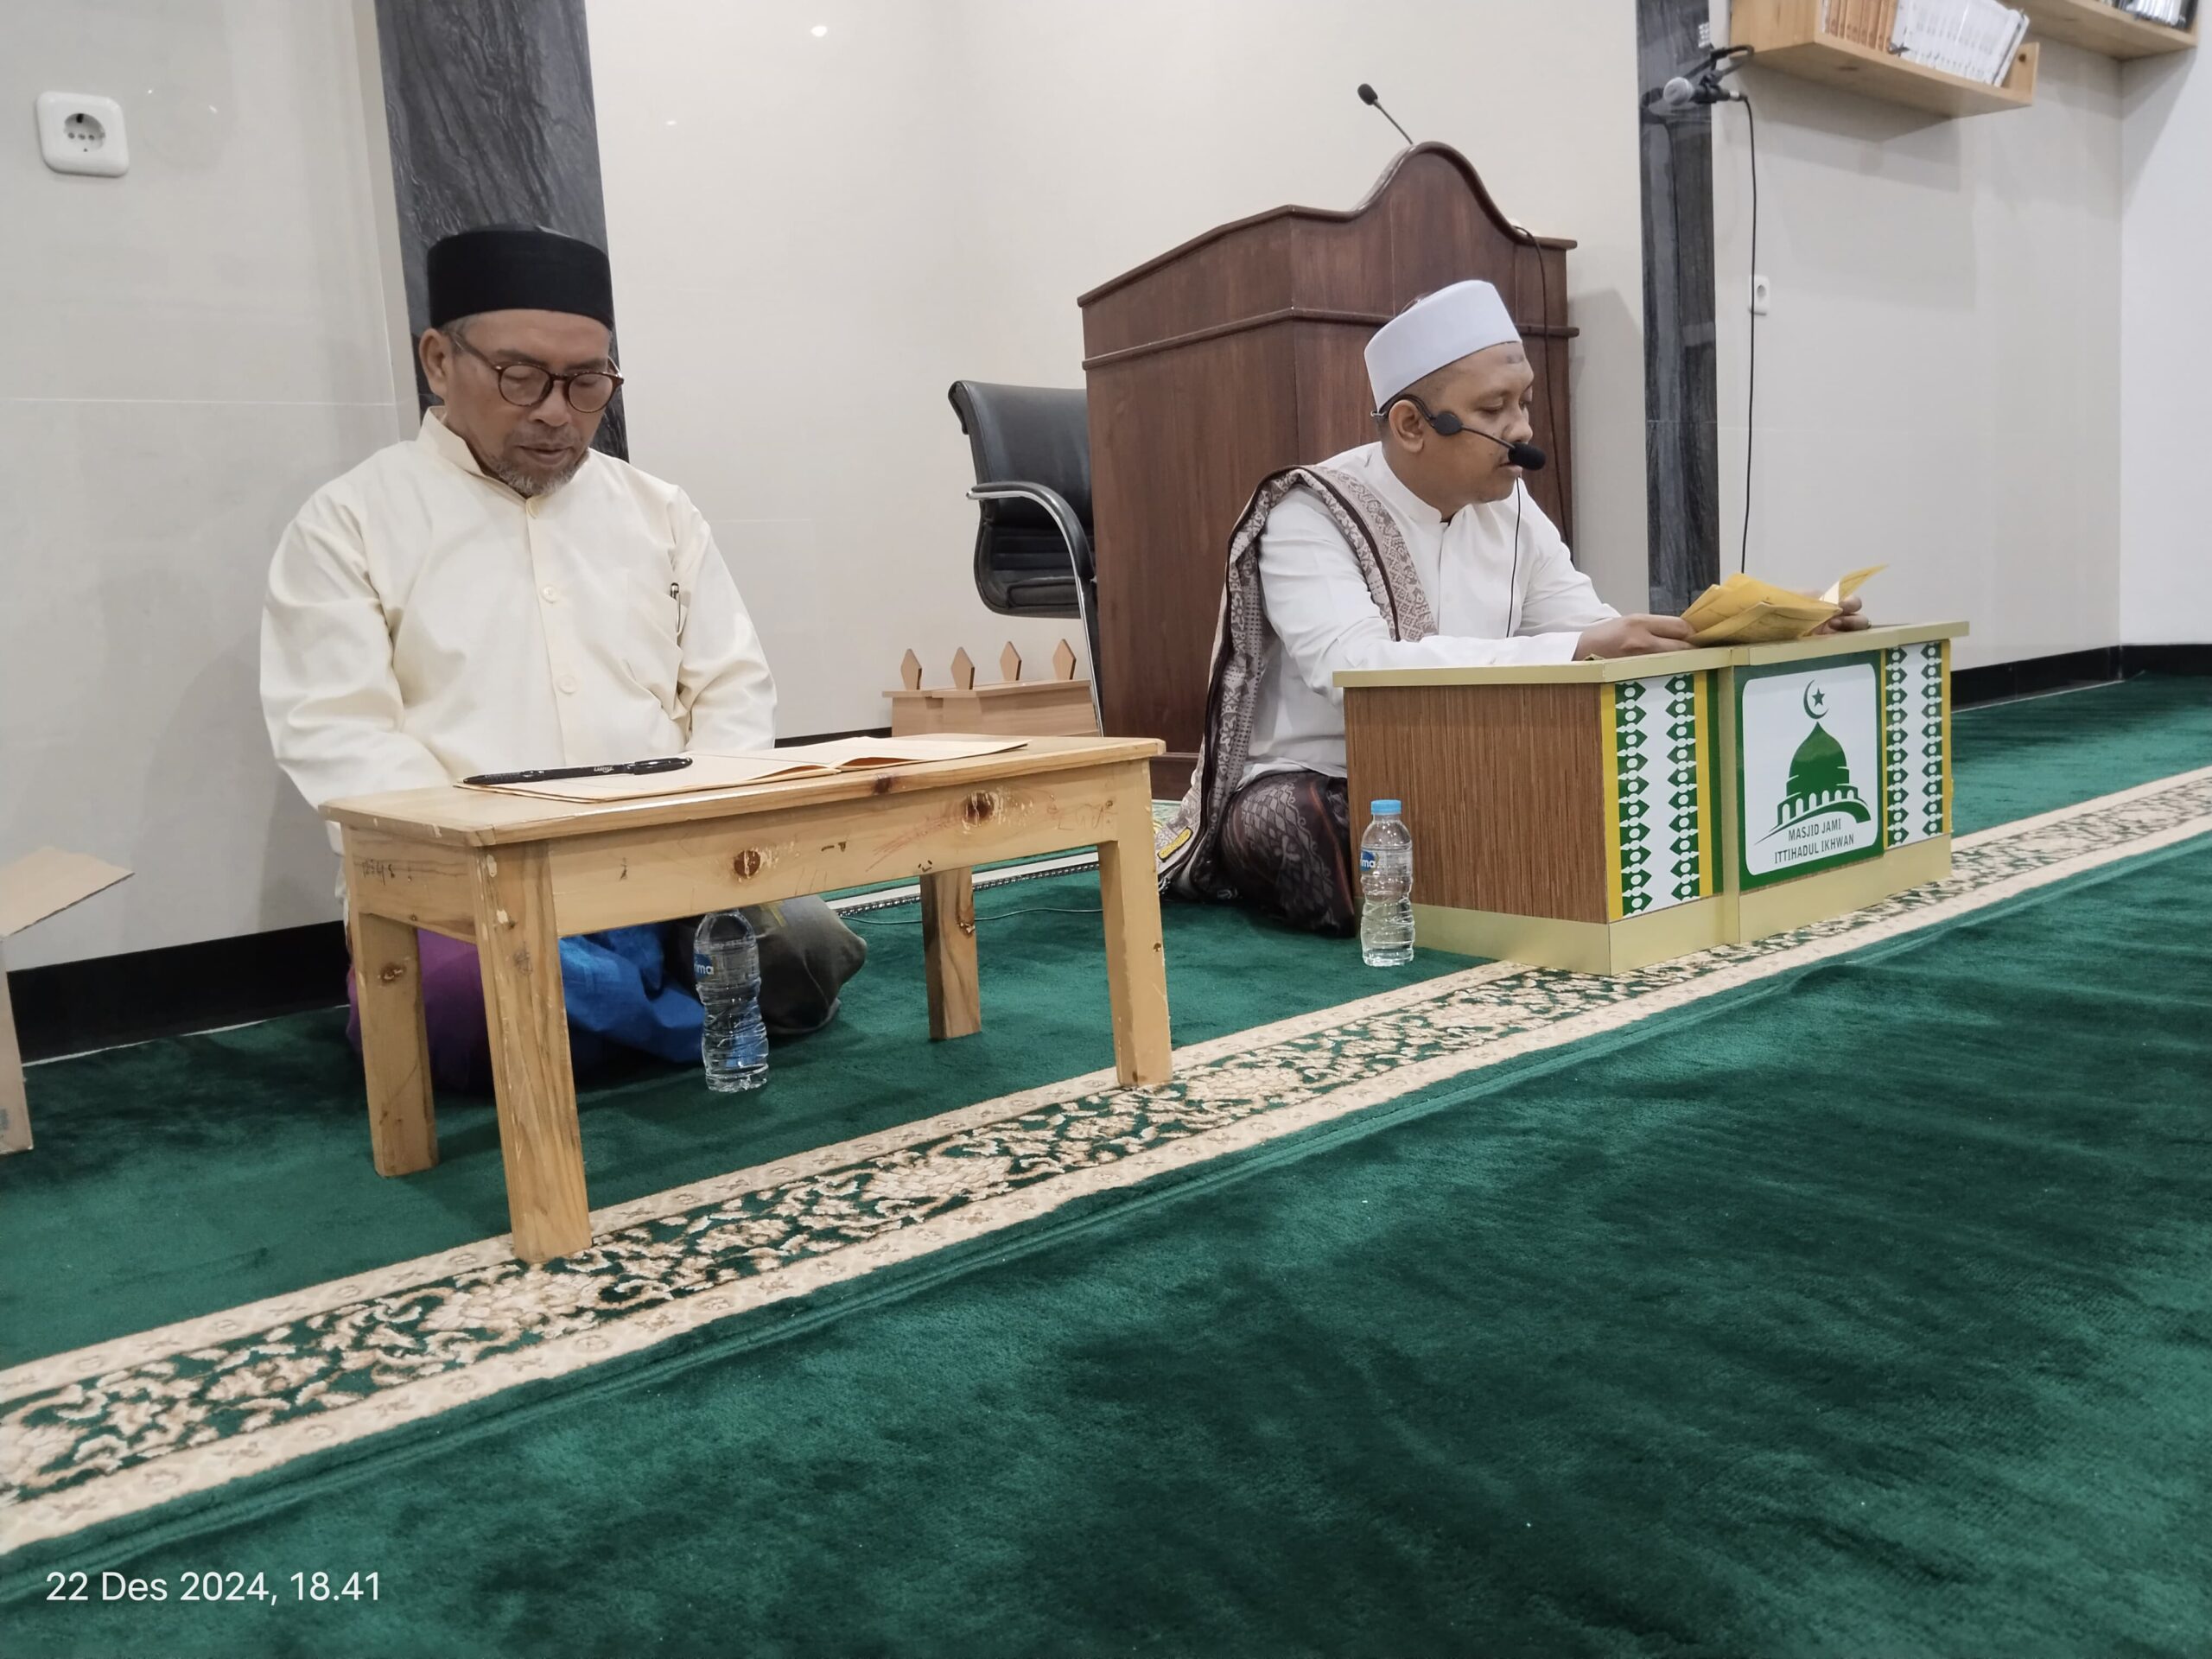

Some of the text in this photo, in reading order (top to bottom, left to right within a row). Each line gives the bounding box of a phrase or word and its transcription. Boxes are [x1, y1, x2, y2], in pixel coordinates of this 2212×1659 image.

[1788, 818, 1841, 842] MASJID JAMI
[1774, 833, 1854, 864] ITTIHADUL IKHWAN
